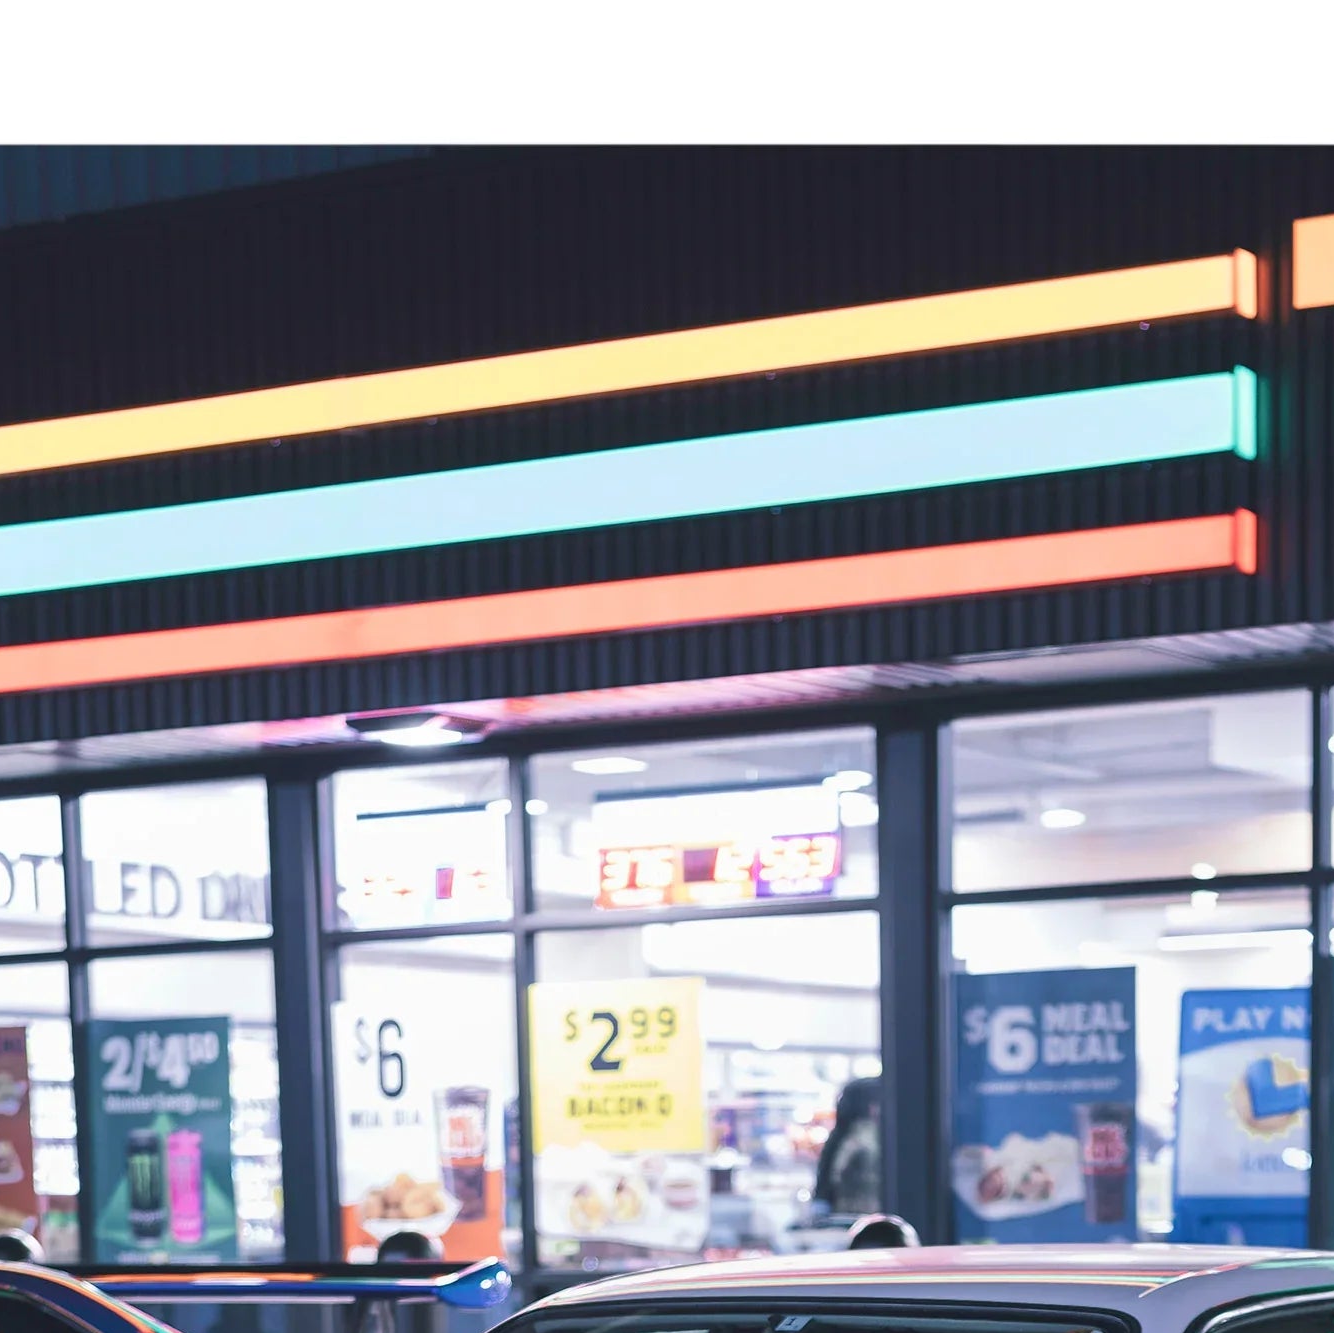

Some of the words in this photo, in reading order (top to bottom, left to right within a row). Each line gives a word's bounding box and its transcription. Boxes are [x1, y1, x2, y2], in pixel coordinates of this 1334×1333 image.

[1193, 1006, 1274, 1033] PLAY
[1281, 1004, 1312, 1032] N
[355, 1018, 405, 1098] $6
